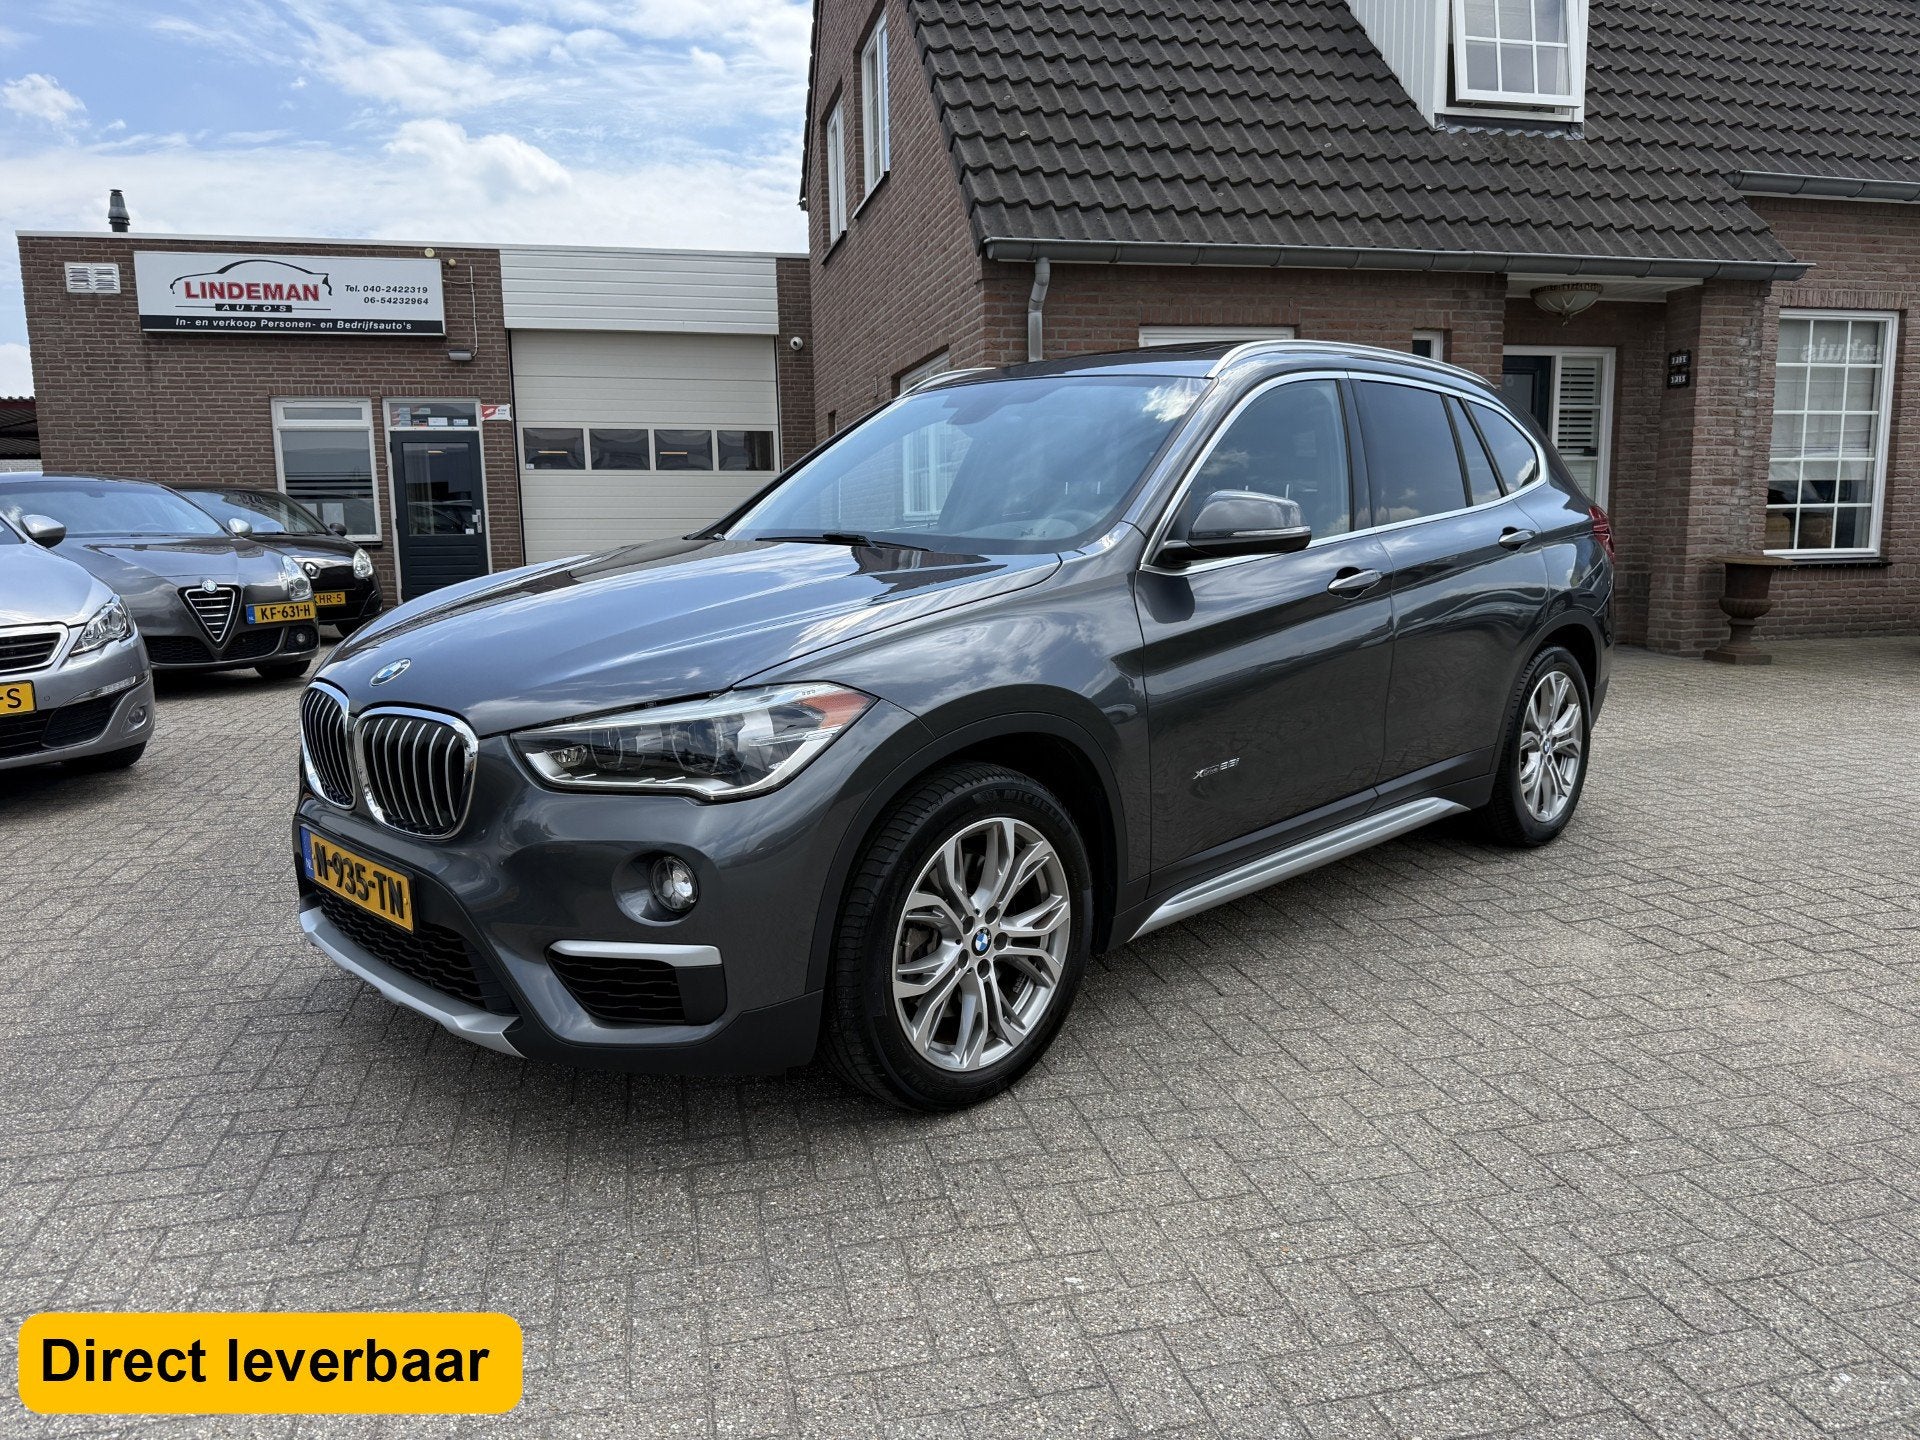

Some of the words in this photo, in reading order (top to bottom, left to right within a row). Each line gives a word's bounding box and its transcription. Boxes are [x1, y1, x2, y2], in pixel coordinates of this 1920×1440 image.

[184, 281, 319, 301] LINDEMAN
[363, 285, 428, 293] 040-2422319
[363, 296, 429, 305] 06-54232964
[221, 304, 287, 312] AUTO'S
[175, 317, 192, 326] In-
[212, 318, 257, 329] verkoop
[260, 319, 316, 328] Personen-
[336, 320, 412, 331] Bedrijfsauto's
[260, 604, 311, 620] KF-631-H
[314, 842, 405, 920] N-935-TN
